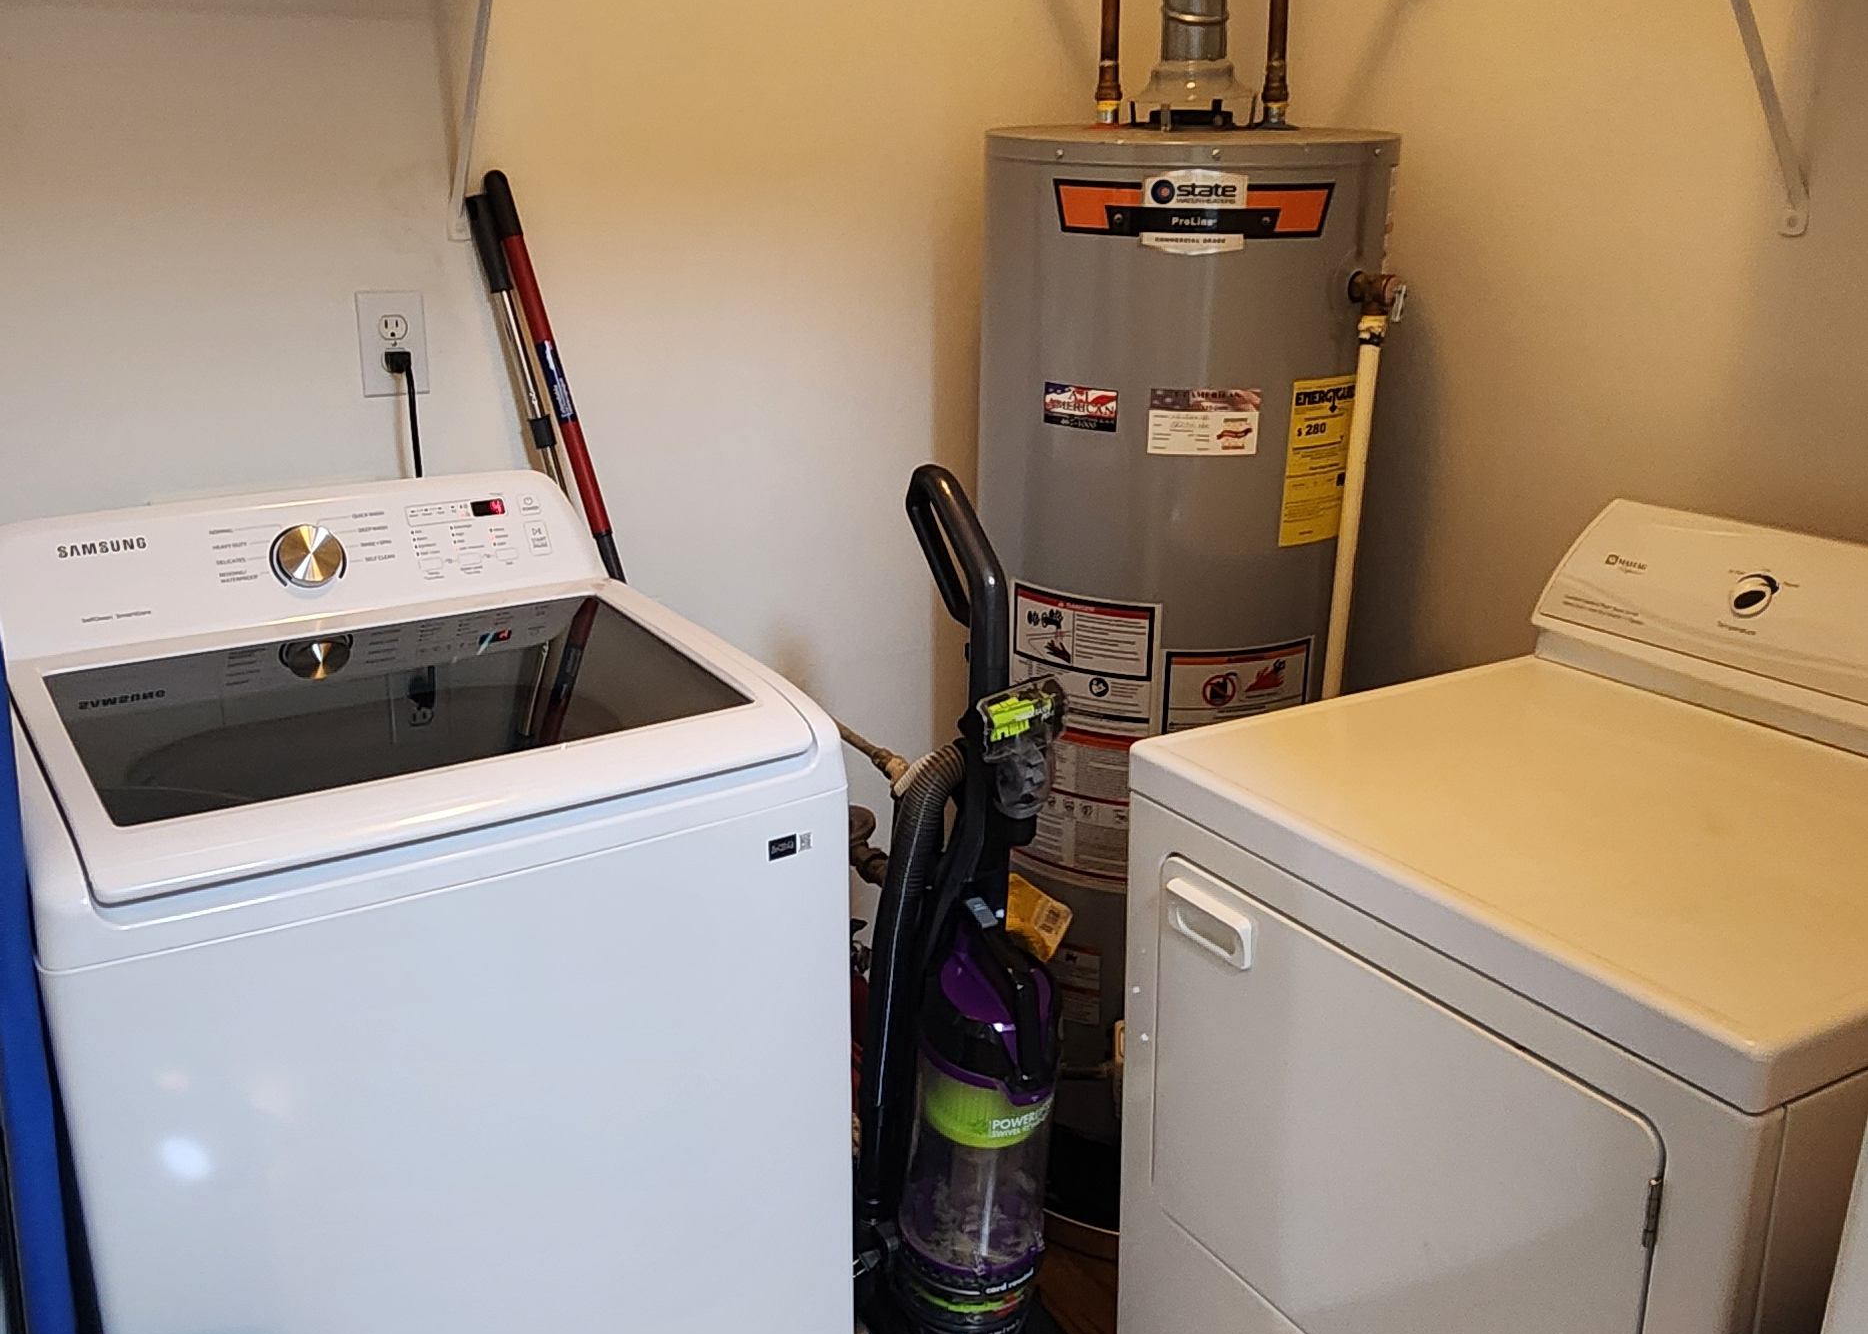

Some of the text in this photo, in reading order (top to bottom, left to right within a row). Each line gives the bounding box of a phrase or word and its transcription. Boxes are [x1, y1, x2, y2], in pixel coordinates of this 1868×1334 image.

[1176, 182, 1237, 198] state
[1296, 421, 1327, 438] $ 280
[57, 537, 147, 559] SAMSUNG
[985, 1281, 1007, 1294] cord
